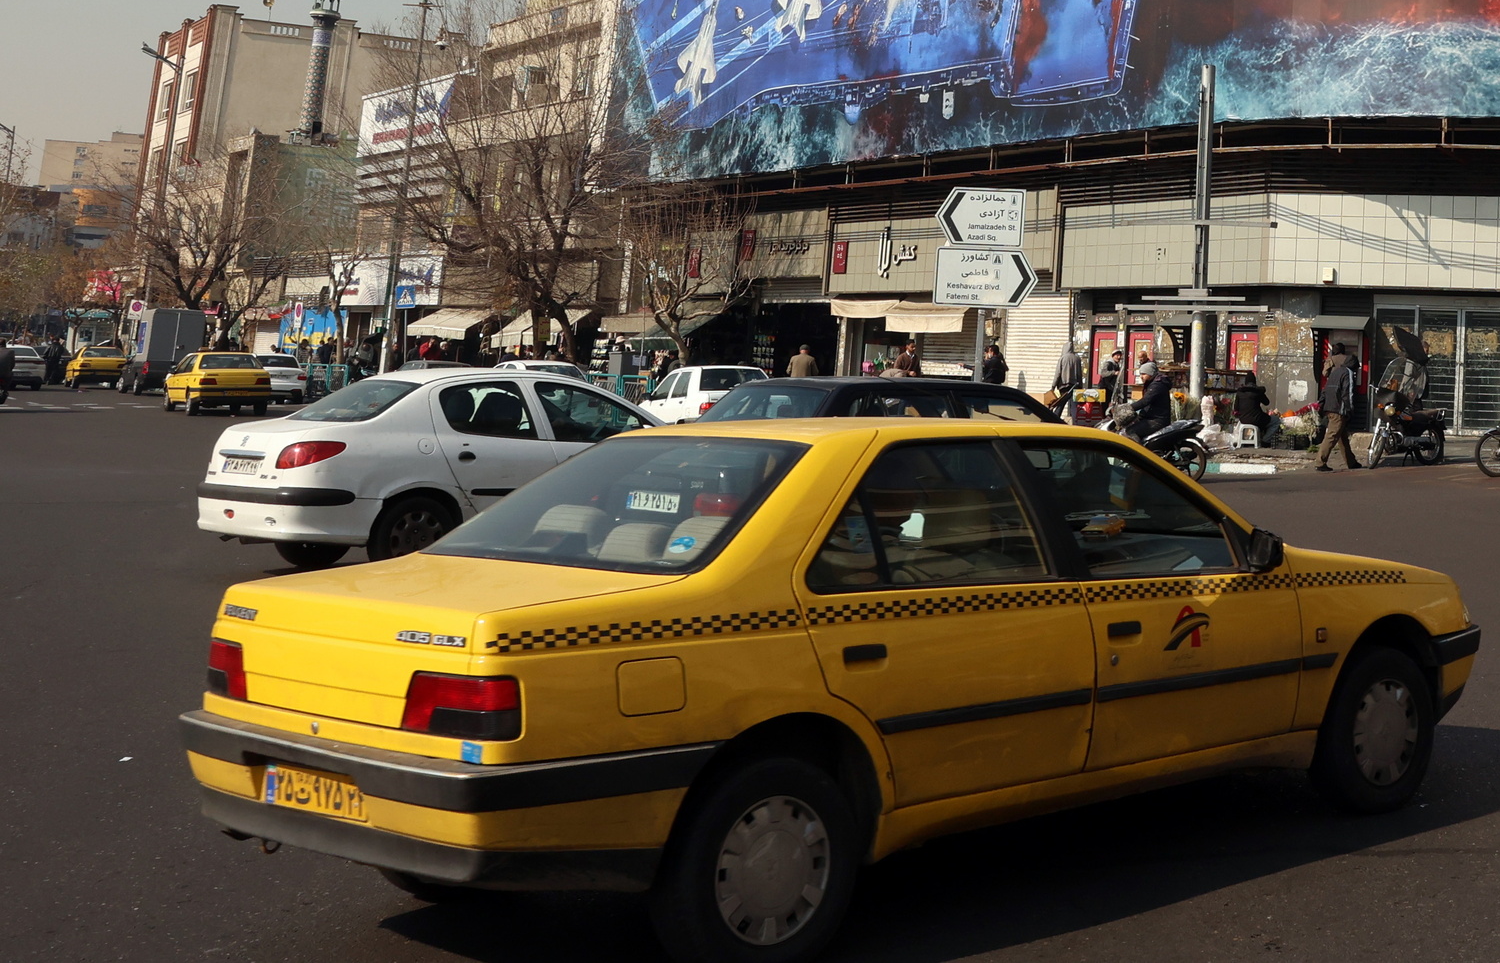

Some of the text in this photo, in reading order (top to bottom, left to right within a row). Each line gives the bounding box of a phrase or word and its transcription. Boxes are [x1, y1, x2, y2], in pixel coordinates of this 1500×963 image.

[970, 194, 1006, 205] جمالزاده
[979, 210, 1005, 219] آزادی
[967, 223, 1006, 231] Jamalzadeh
[987, 234, 997, 242] Sq.
[893, 244, 917, 264] کفش
[961, 253, 990, 263] کشاورز
[961, 268, 989, 278] فاطمی
[947, 282, 1001, 291] Keshavarz Blvd.
[971, 293, 980, 301] St.
[396, 630, 466, 647] 405 GLX
